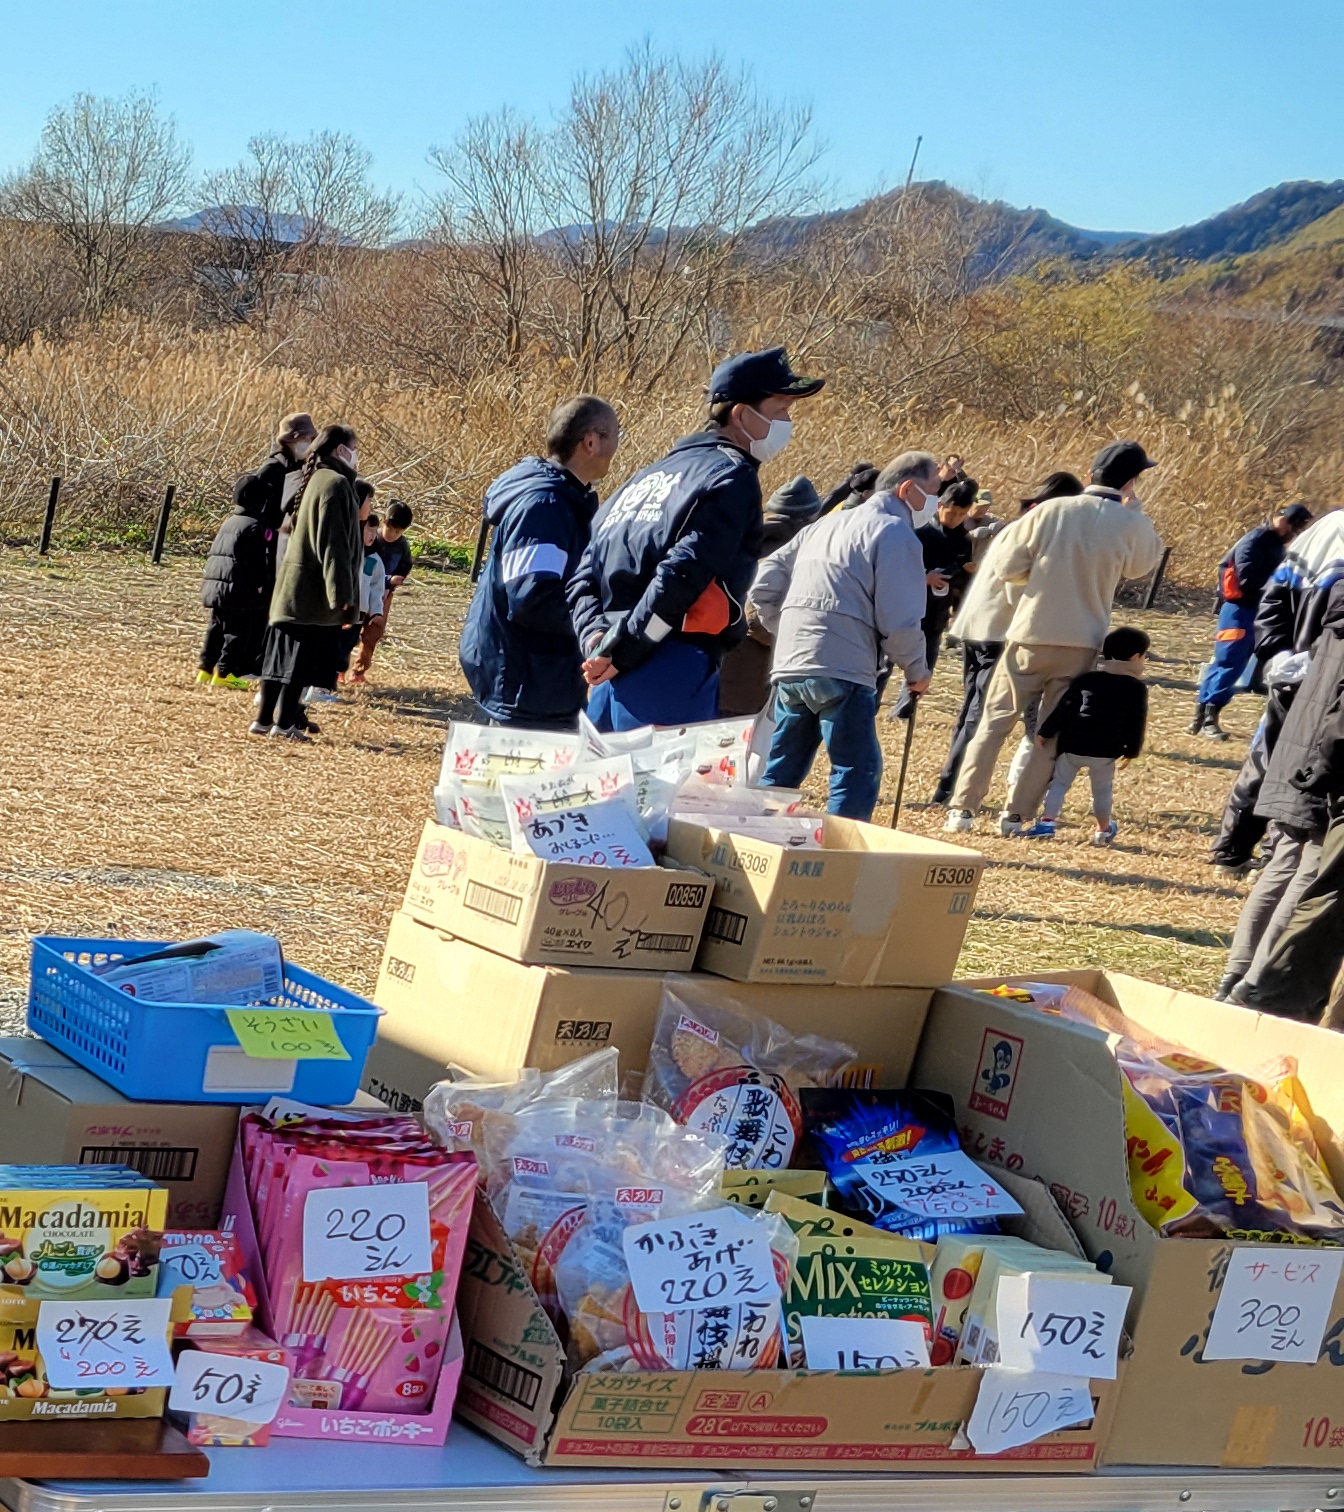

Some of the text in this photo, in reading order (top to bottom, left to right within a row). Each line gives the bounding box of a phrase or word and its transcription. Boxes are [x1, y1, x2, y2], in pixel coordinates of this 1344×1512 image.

[730, 851, 768, 874] 15308
[786, 860, 825, 877] 丸美屋
[927, 865, 976, 886] 15308
[667, 885, 705, 907] 00850
[244, 1013, 319, 1034] そうざい
[555, 1020, 612, 1041] 天乃屋
[617, 1188, 663, 1204] 天乃屋
[325, 1208, 407, 1242] 220
[363, 1245, 413, 1272] えん
[868, 1260, 917, 1277] ミックス
[790, 1252, 858, 1302] Mix
[1244, 1261, 1321, 1284] サービス
[340, 1286, 401, 1304] いちご
[860, 1276, 929, 1294] セレクション
[1236, 1298, 1301, 1334] 300
[1270, 1328, 1306, 1351] えん
[593, 1376, 678, 1393] メガサイズ
[30, 1398, 119, 1416] Macadamia
[590, 1396, 669, 1413] 菓子詰合せ
[700, 1392, 741, 1409] 定温
[320, 1415, 434, 1438] いちごポッキー
[596, 1414, 644, 1431] 10袋入
